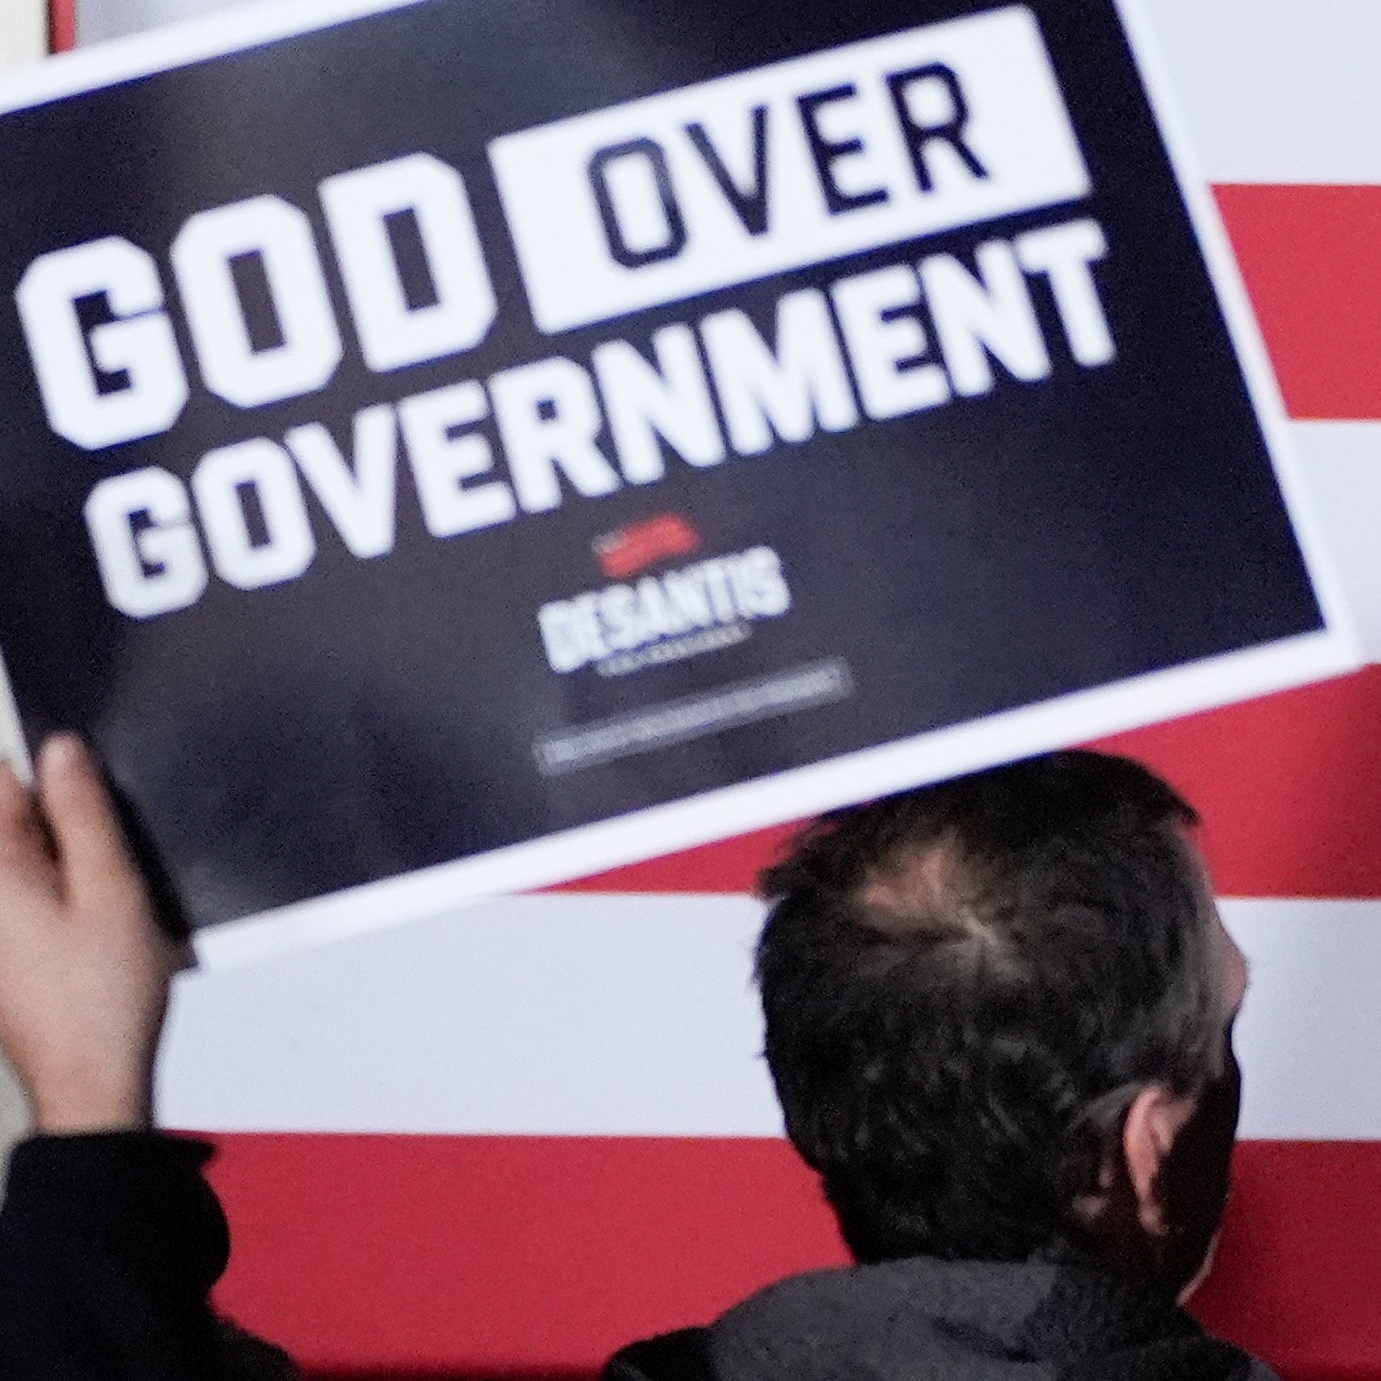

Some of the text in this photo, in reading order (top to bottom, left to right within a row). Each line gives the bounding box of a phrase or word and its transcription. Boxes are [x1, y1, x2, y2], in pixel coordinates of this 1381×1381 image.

[16, 61, 990, 451] GOD OVER
[84, 219, 1116, 620] GOVERNMENT
[537, 545, 792, 673] DESANTIS
